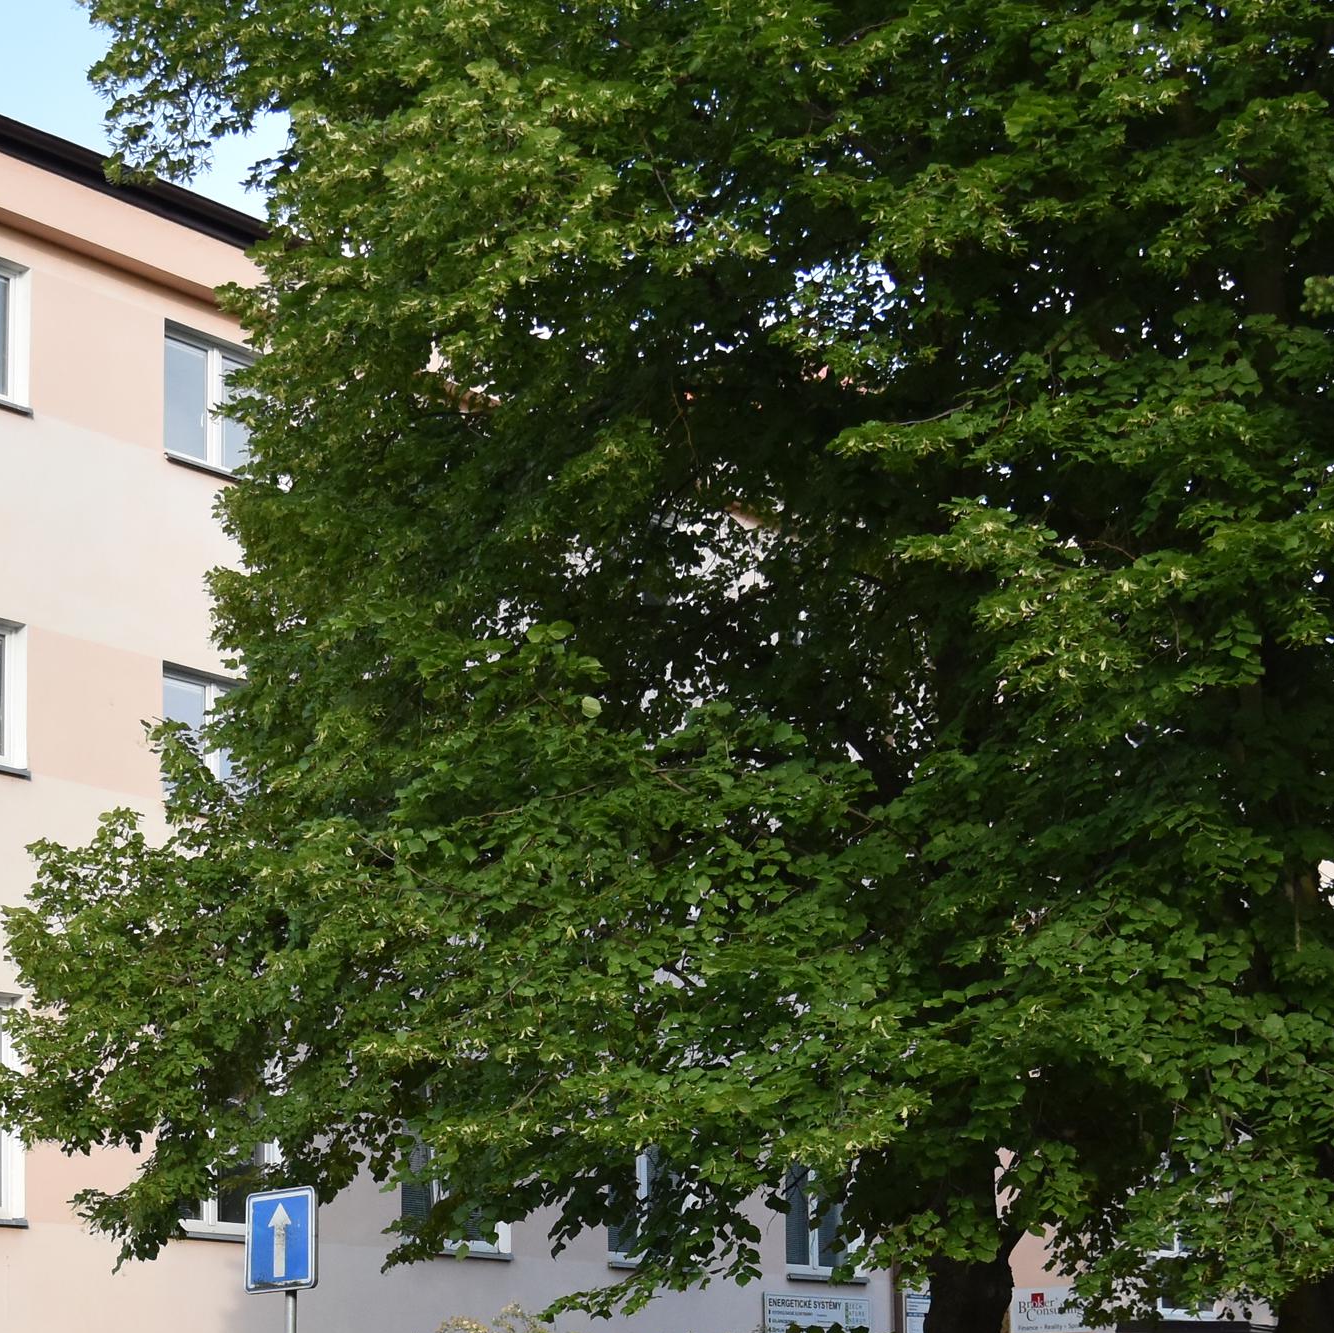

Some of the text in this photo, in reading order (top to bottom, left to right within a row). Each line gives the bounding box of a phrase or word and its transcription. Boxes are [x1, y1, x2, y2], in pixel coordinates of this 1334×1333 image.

[768, 1297, 842, 1311] ENERGETICKÉ SYSTÉMY
[1018, 1296, 1054, 1314] Broker
[1026, 1303, 1082, 1322] Consuing
